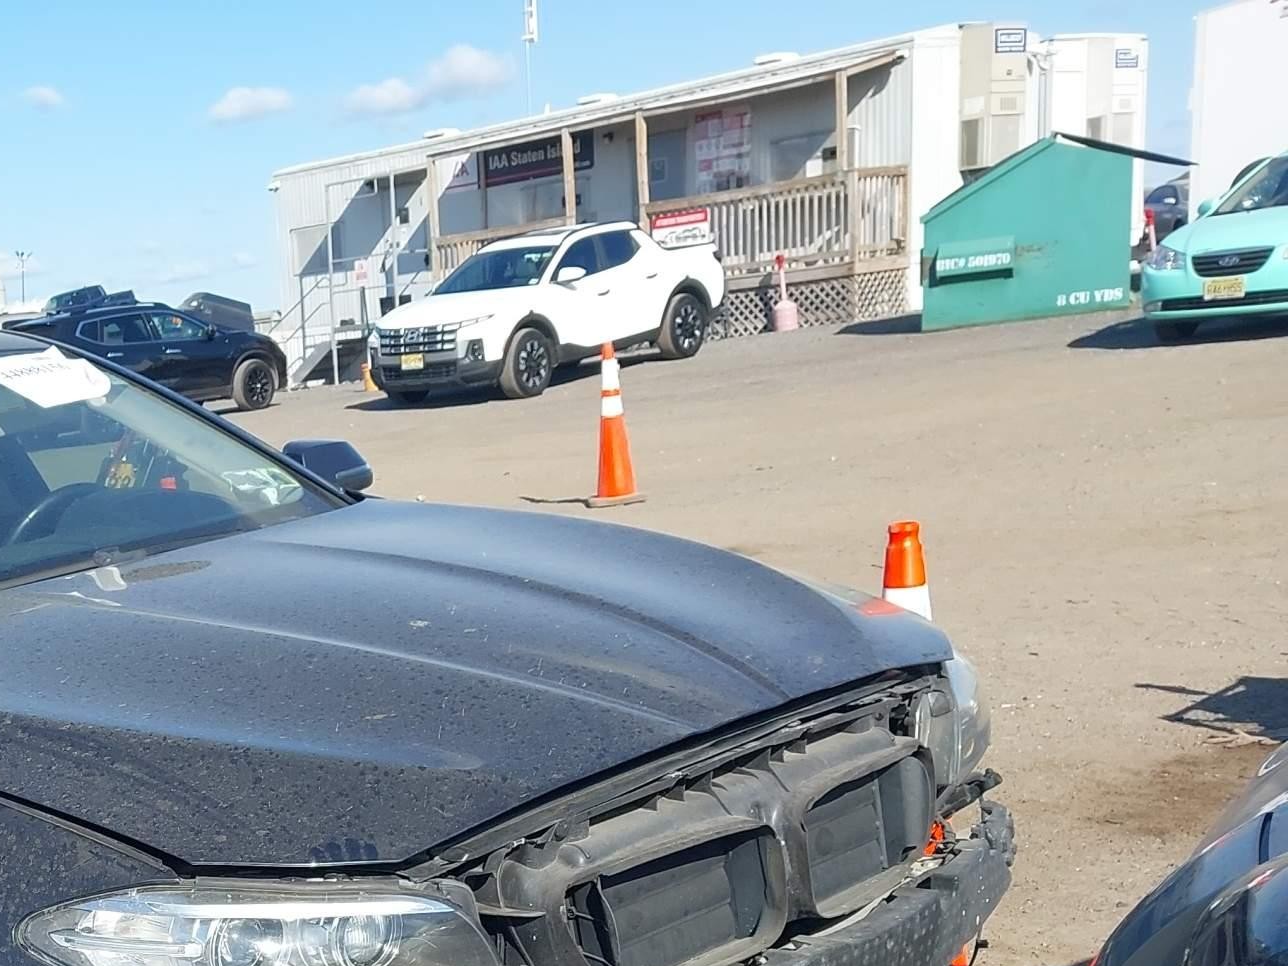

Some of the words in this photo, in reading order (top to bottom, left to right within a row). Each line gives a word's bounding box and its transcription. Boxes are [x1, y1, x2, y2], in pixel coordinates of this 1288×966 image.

[488, 151, 510, 171] IAA
[511, 148, 545, 167] Staten
[547, 138, 581, 159] Isld
[1069, 291, 1090, 305] CU
[1094, 288, 1124, 303] YDS
